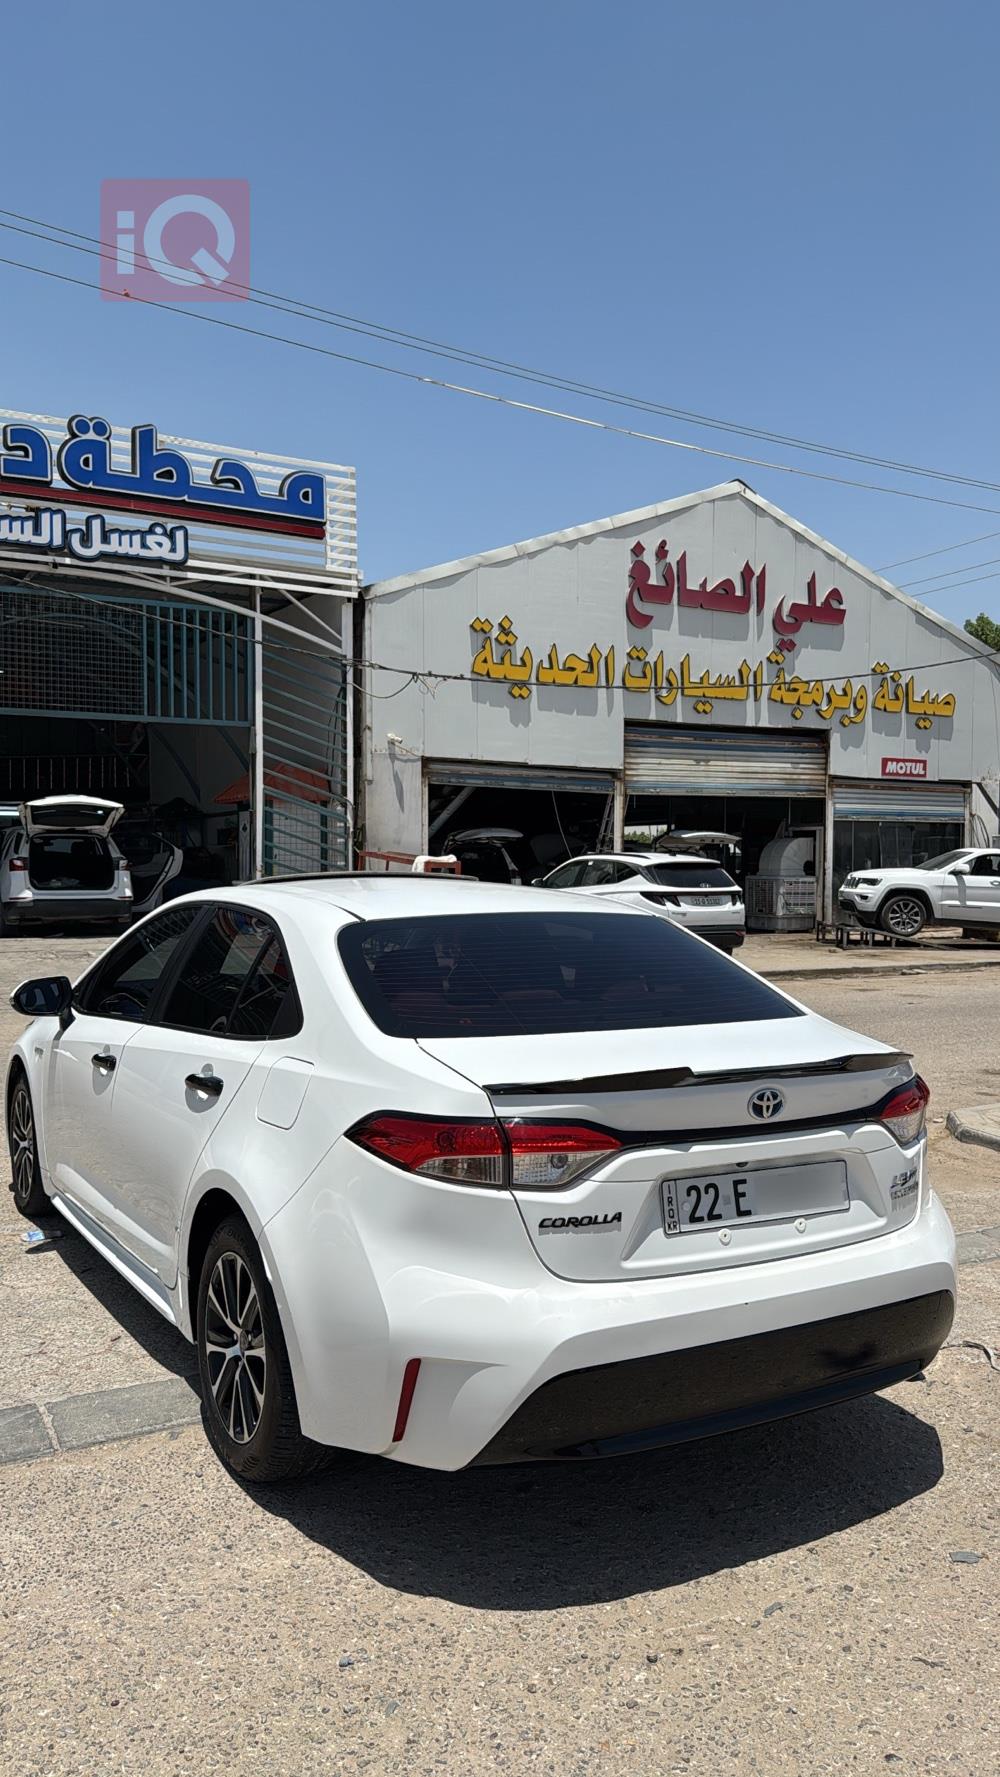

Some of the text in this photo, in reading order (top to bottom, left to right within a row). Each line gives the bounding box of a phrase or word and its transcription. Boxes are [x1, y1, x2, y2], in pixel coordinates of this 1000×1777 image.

[57, 415, 327, 525] محطة
[67, 514, 189, 566] لغسل
[626, 539, 847, 652] علي الصائغ
[469, 615, 957, 730] صيانة وبرمجة السيارات الحديثة
[885, 760, 926, 775] MOTUL
[538, 1211, 623, 1229] COROLLA
[686, 1178, 753, 1223] 22 E
[666, 1220, 678, 1232] KR
